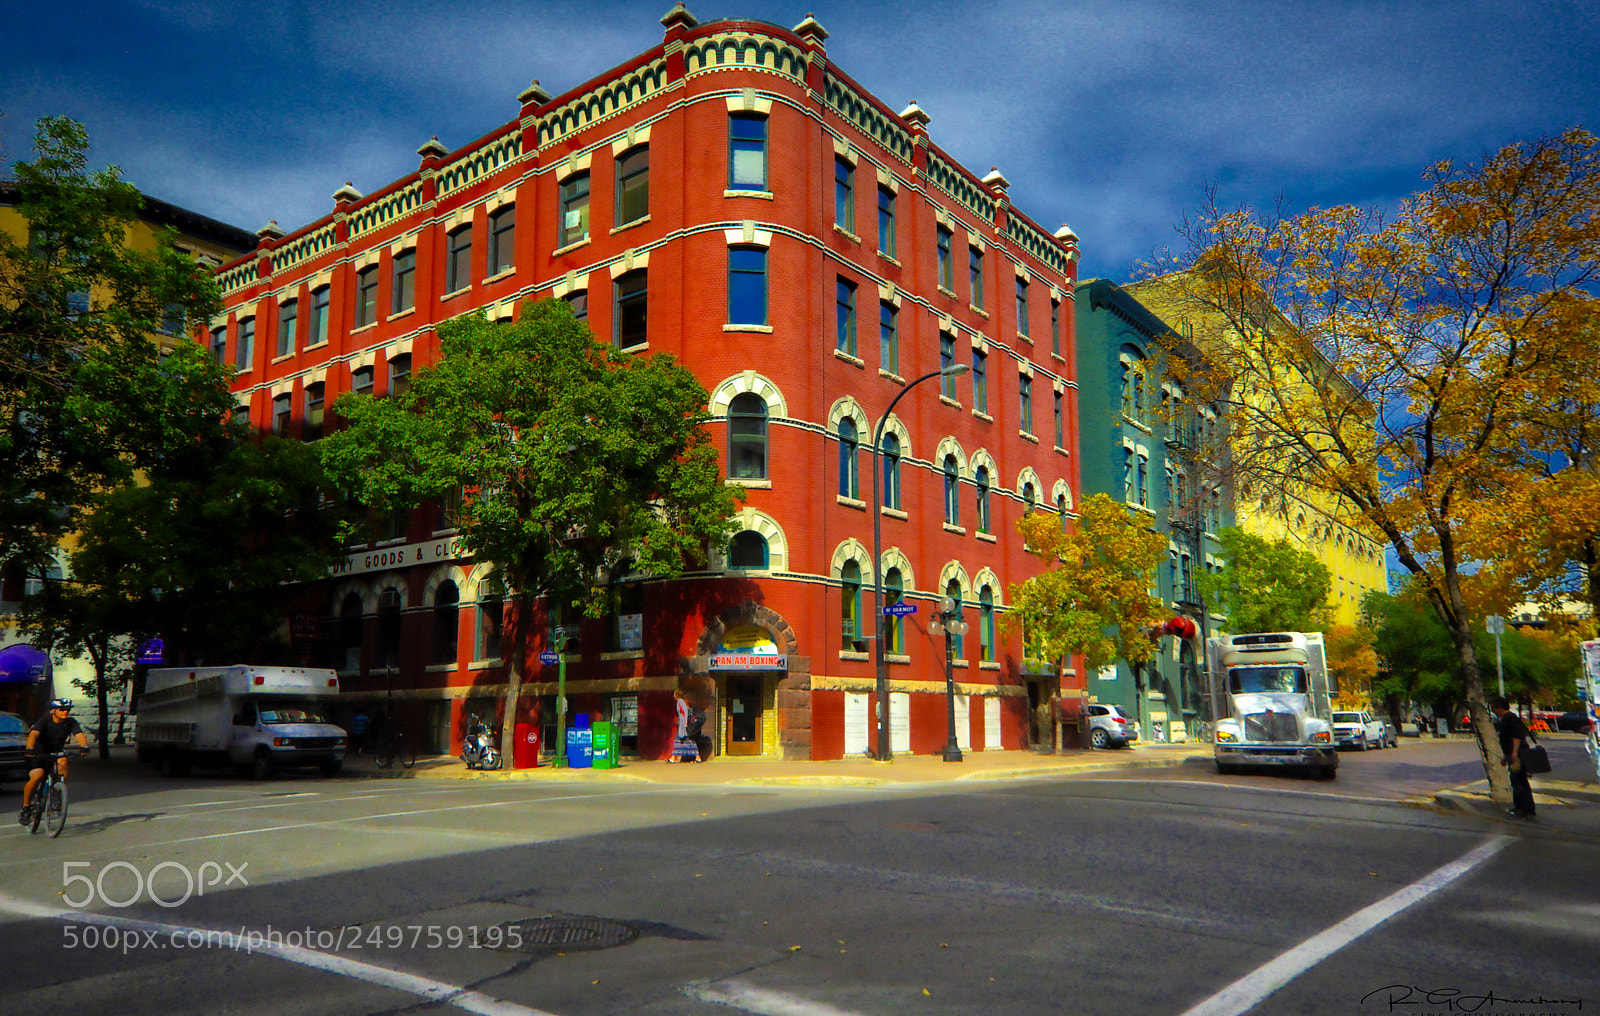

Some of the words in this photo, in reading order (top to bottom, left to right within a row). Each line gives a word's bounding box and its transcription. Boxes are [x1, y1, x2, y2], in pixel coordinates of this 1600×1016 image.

[365, 550, 404, 568] GOODS
[416, 547, 423, 560] &
[716, 656, 732, 665] PAN
[734, 656, 747, 665] AM
[749, 656, 779, 665] BOXING
